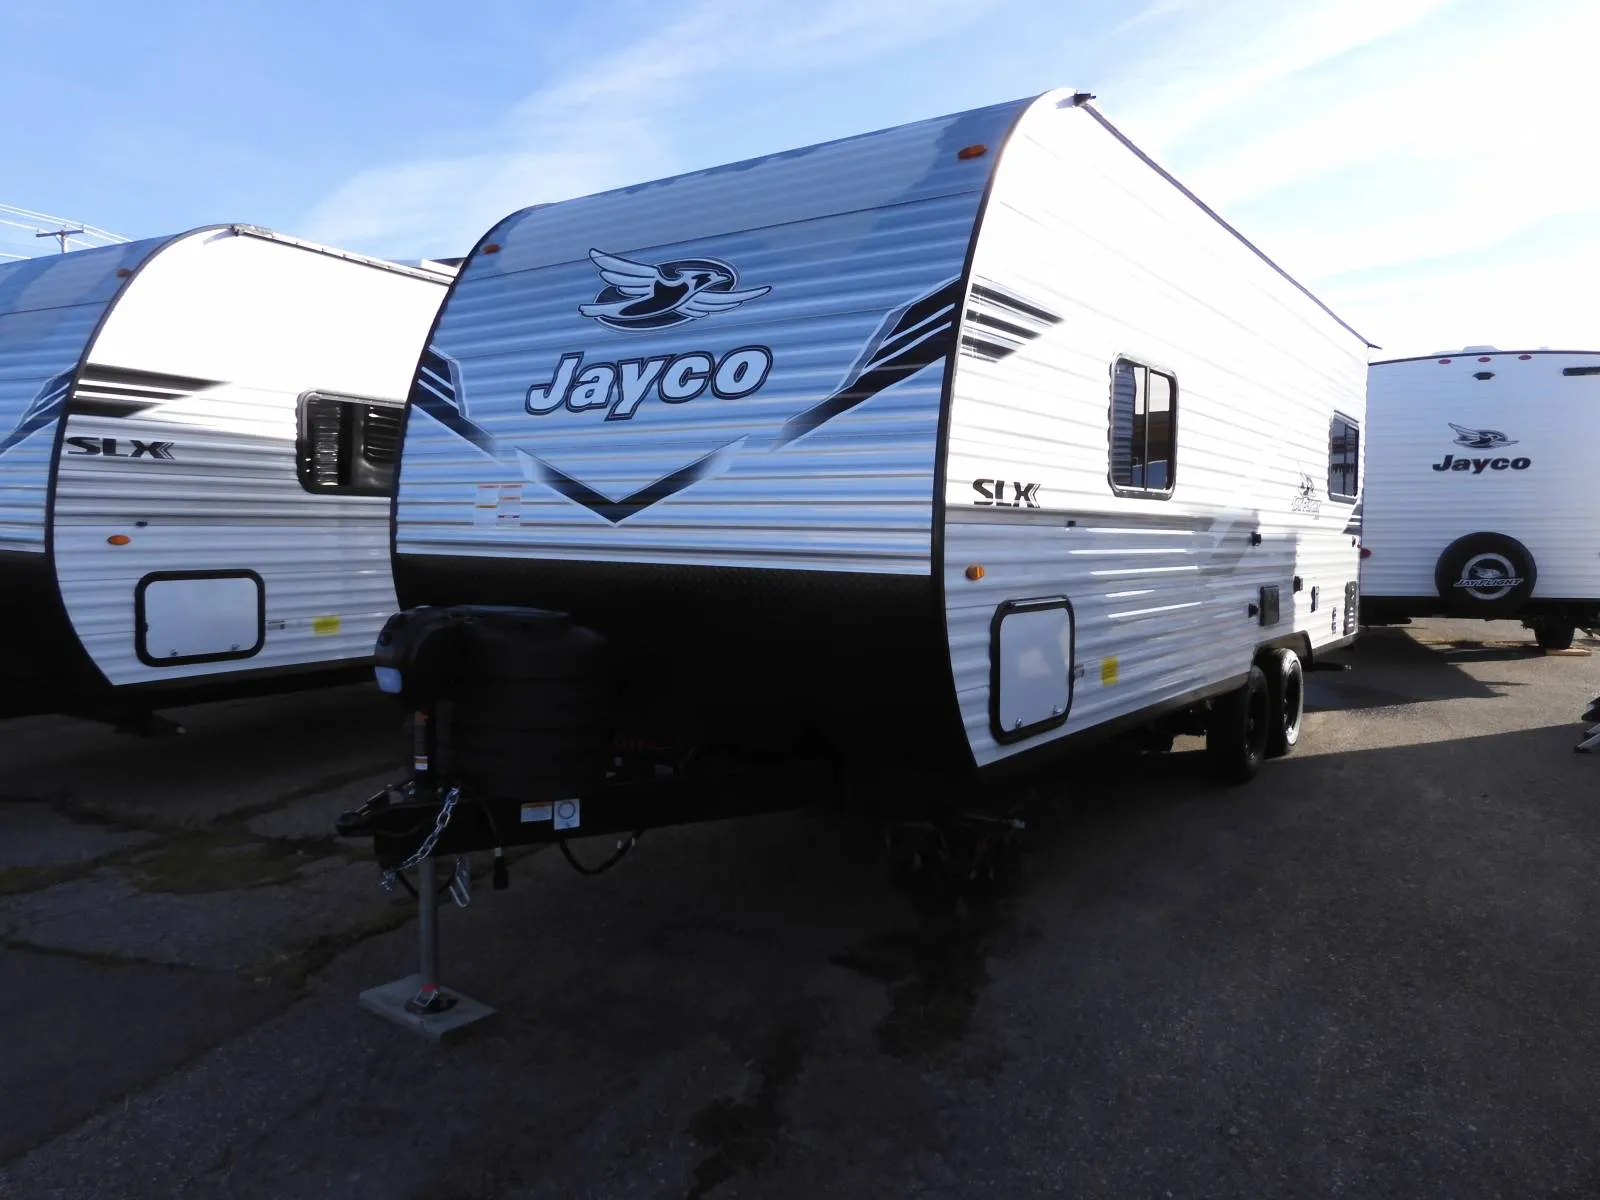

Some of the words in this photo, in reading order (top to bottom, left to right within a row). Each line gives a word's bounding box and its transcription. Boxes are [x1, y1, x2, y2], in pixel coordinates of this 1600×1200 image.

[525, 344, 773, 421] Jayco
[65, 436, 174, 461] SLX
[1432, 454, 1532, 474] Jayco
[972, 478, 1040, 509] SLX
